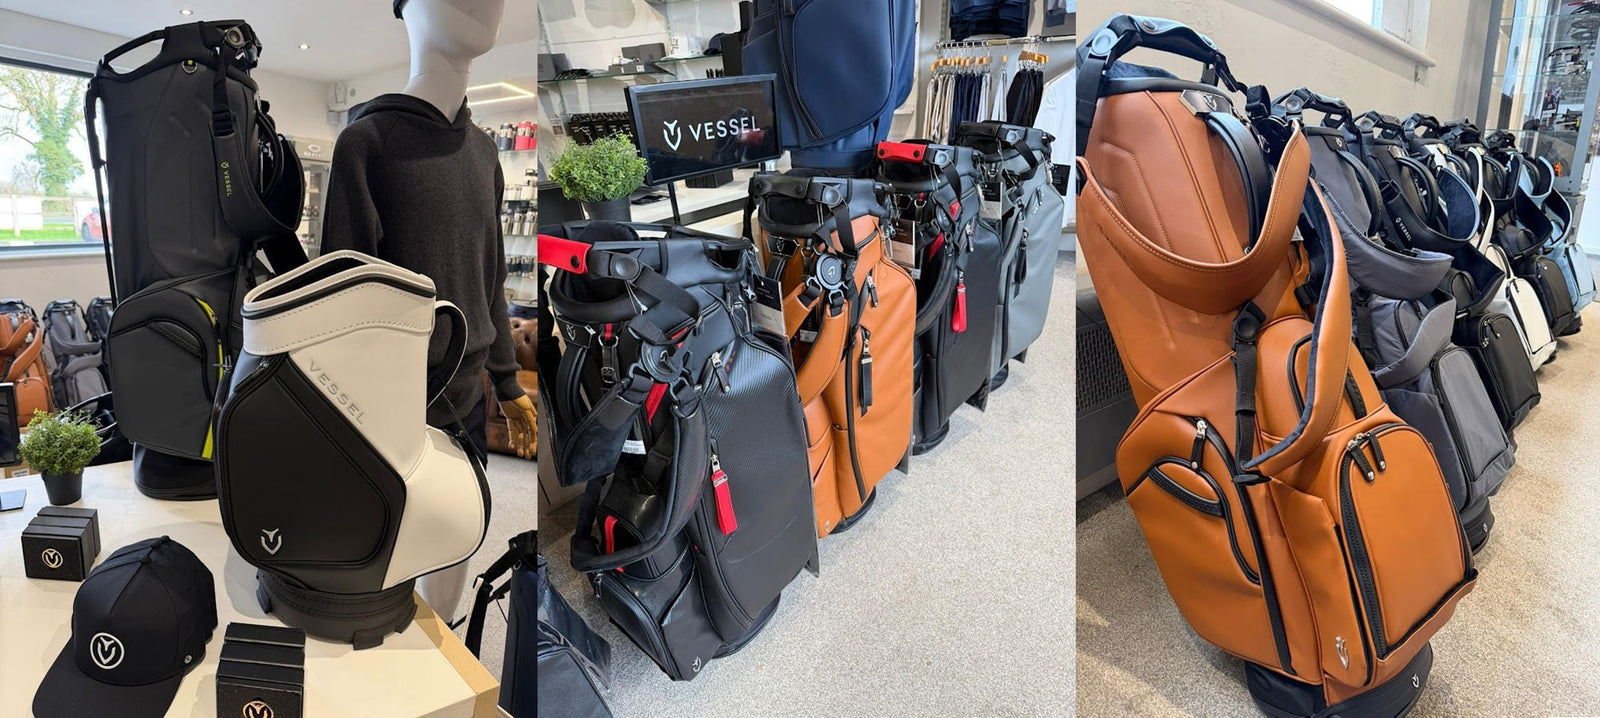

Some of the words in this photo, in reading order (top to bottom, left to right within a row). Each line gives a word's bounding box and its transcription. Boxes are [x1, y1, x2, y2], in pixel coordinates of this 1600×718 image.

[689, 116, 760, 142] VESSEL
[224, 170, 232, 197] VESSEL
[309, 361, 364, 426] VESSEL
